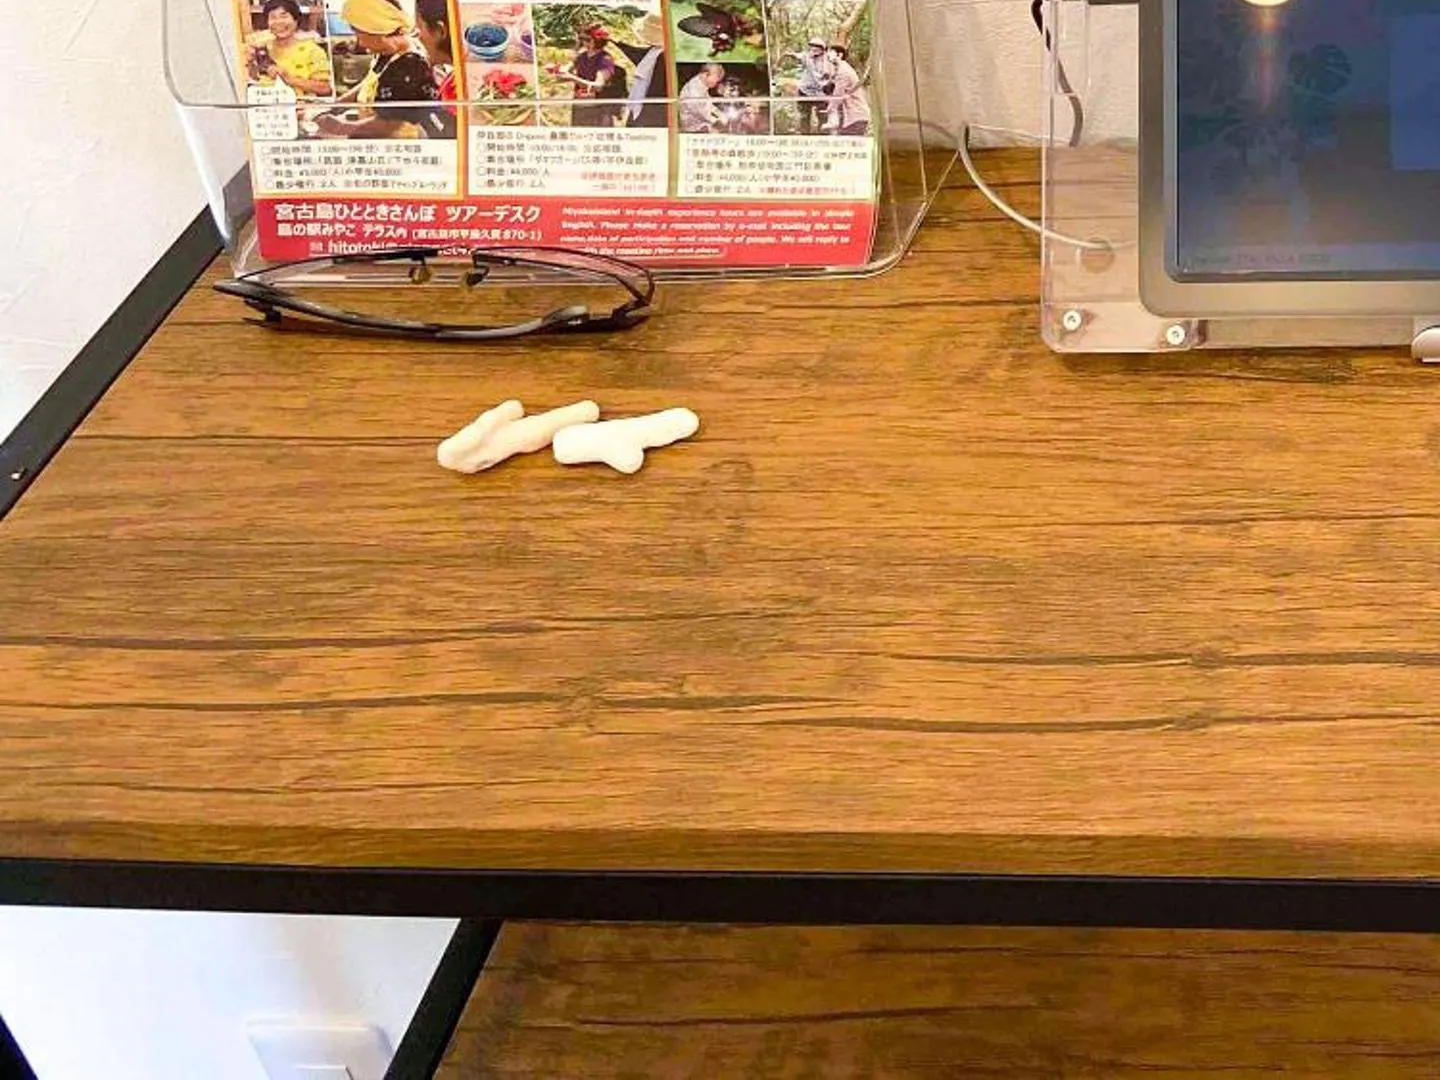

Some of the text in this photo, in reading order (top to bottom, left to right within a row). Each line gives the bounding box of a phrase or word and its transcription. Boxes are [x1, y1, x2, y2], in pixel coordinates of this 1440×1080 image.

[275, 202, 541, 224] 宮古島ひとときさんぽ ツアーデスク
